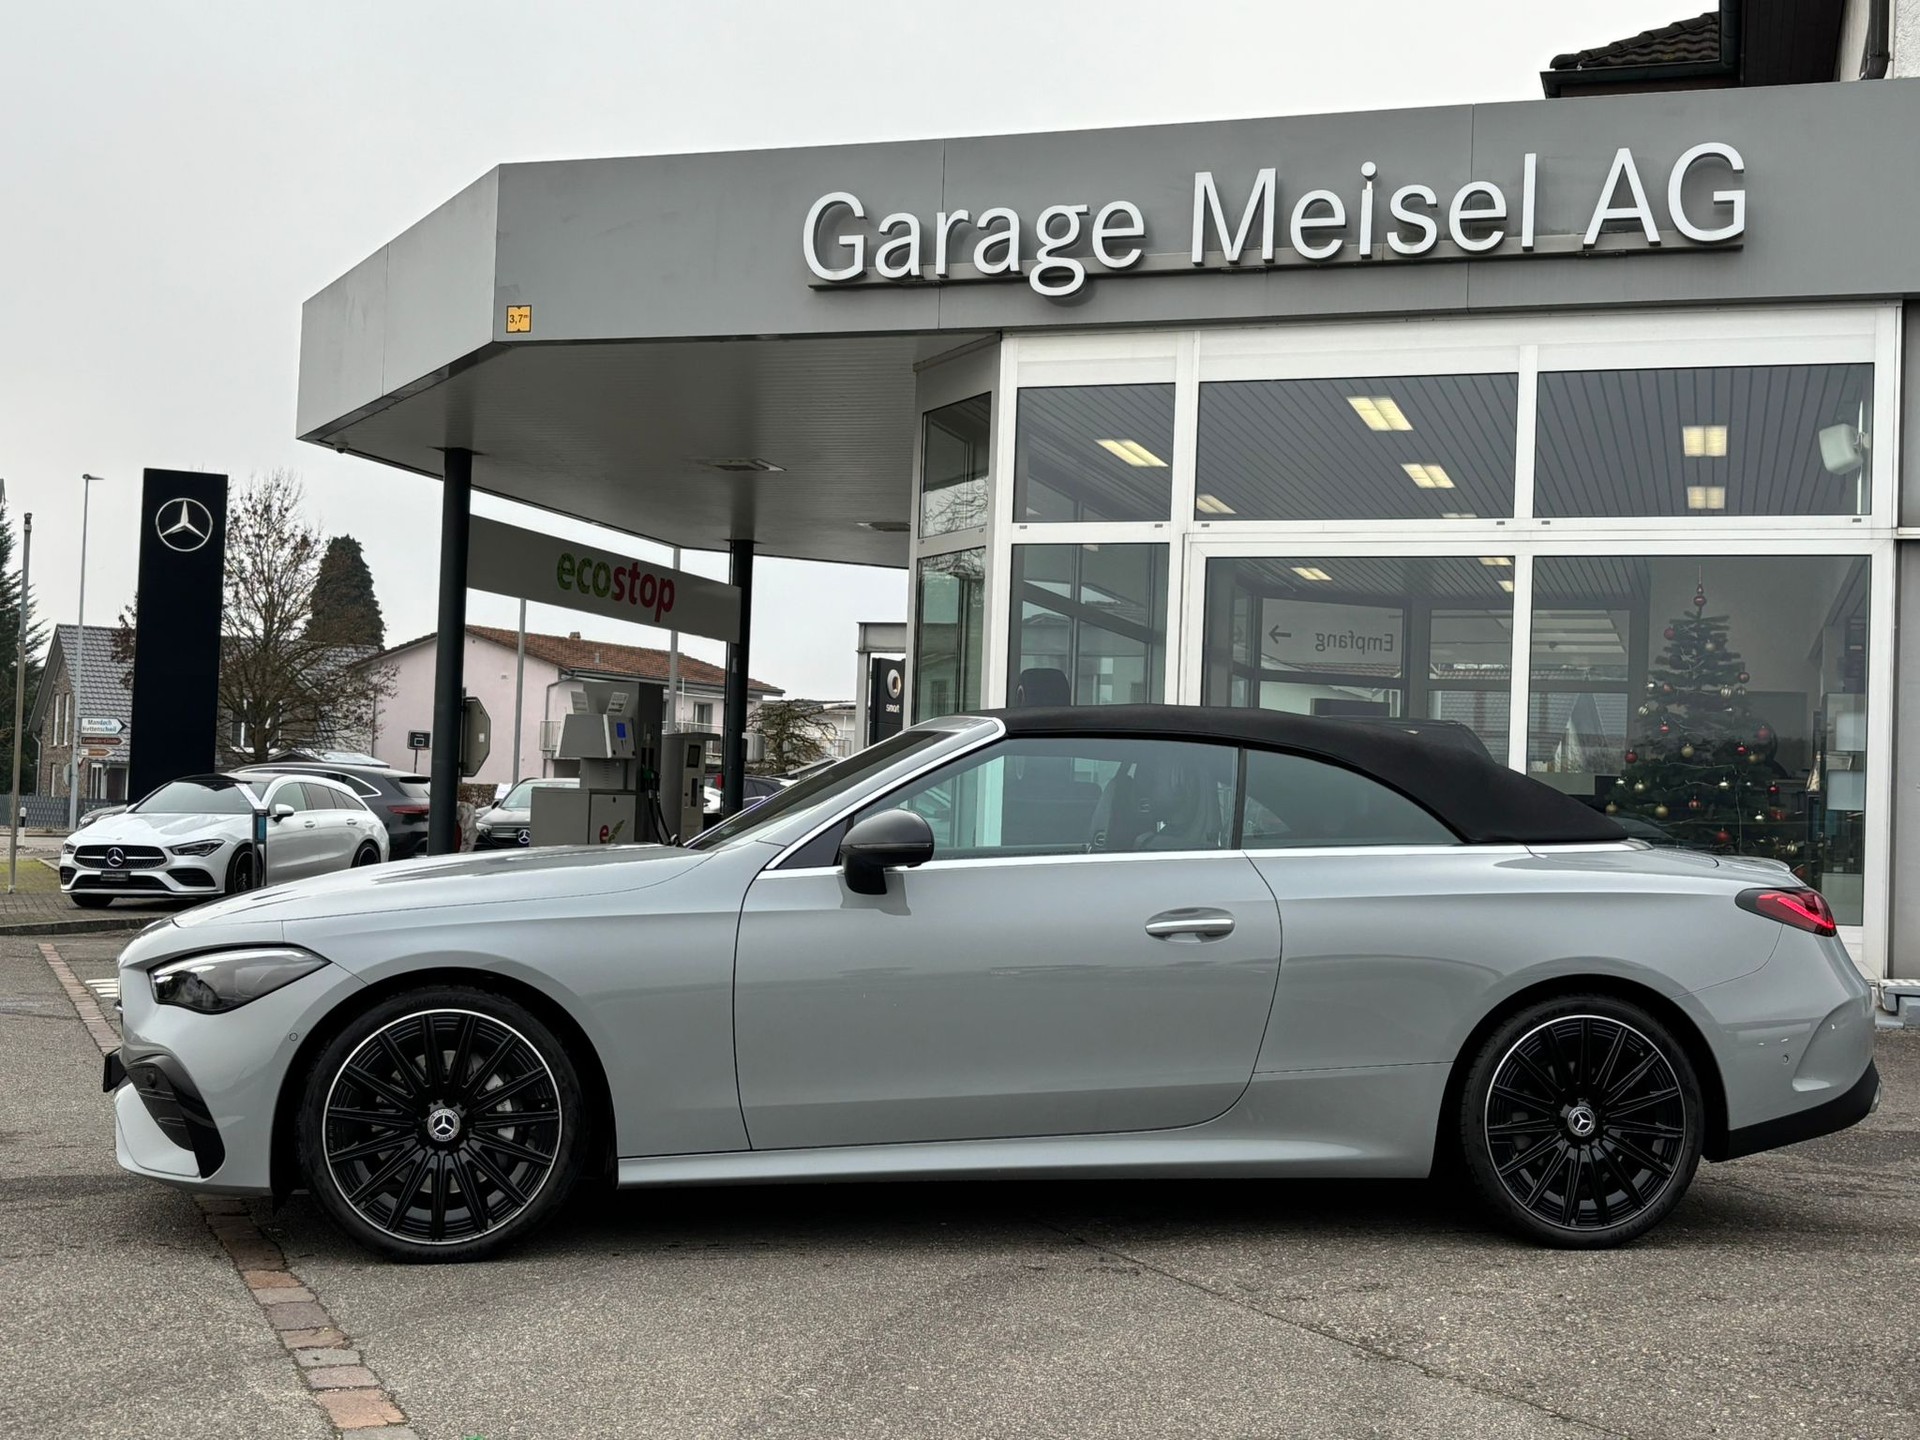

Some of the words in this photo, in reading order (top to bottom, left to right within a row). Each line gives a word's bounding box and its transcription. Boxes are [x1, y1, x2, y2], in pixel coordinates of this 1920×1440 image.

[803, 191, 1145, 296] Garage
[1192, 152, 1537, 264] Meisel
[1583, 142, 1746, 246] AG
[556, 552, 675, 623] ecostop
